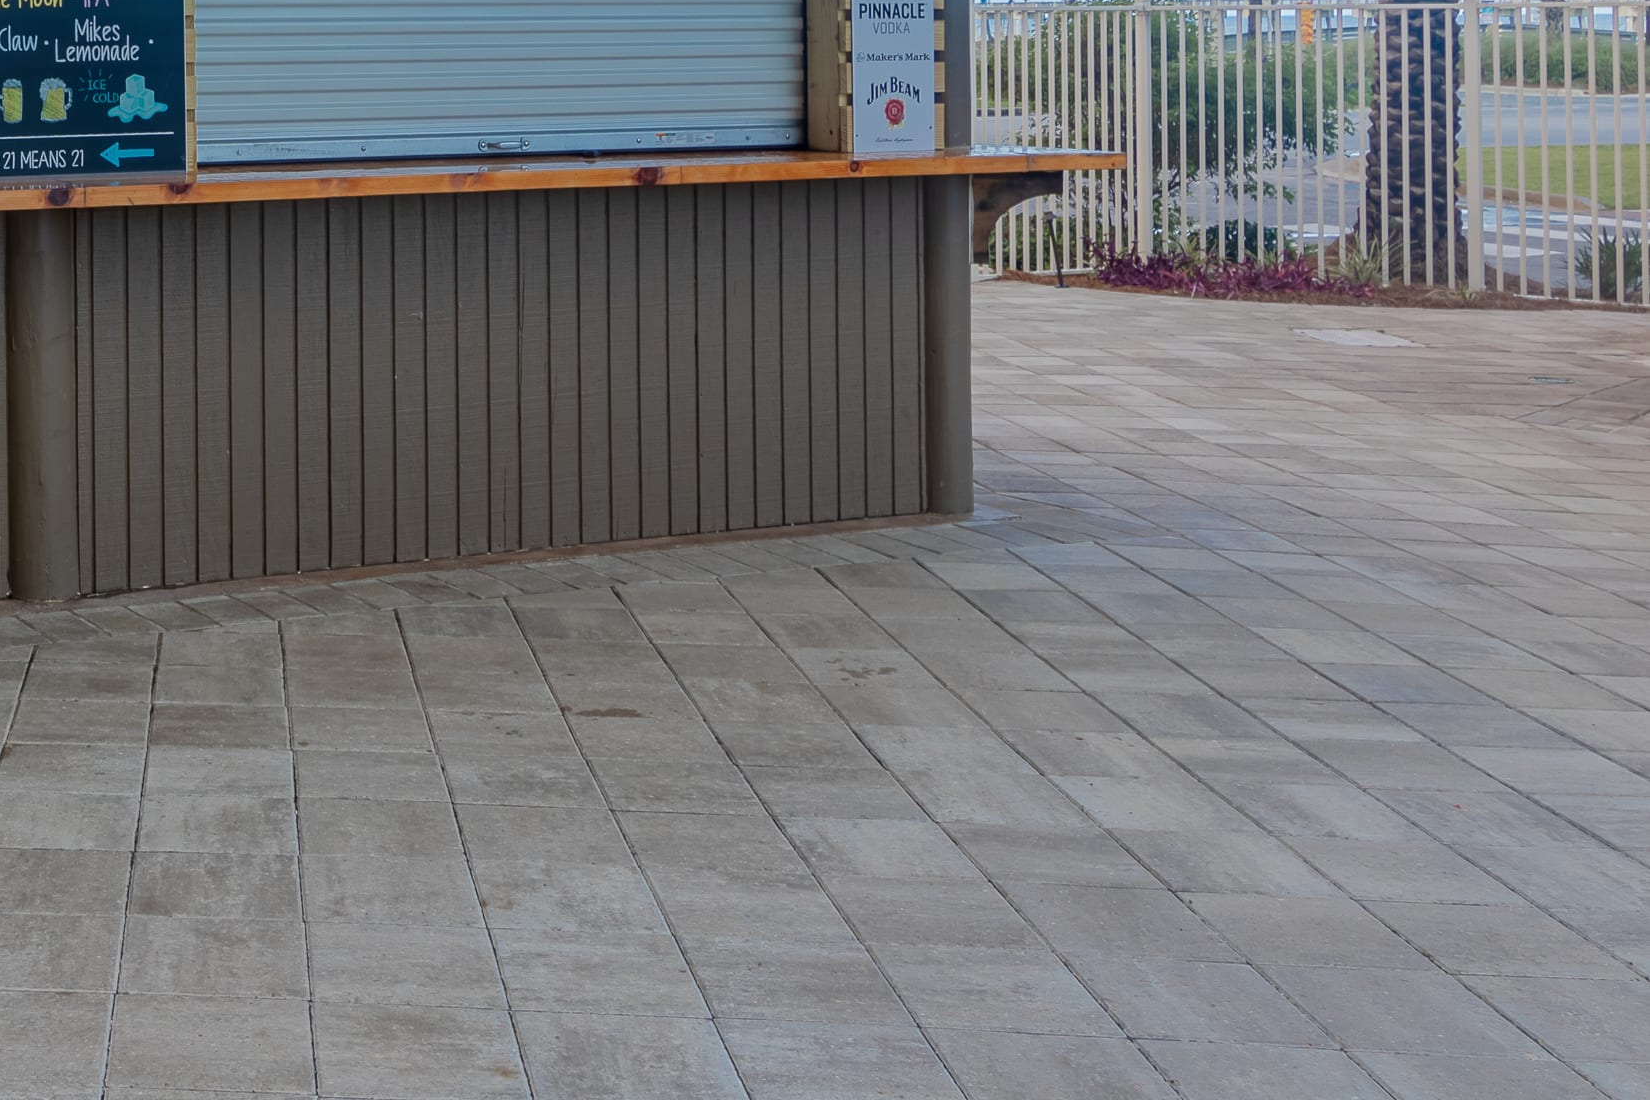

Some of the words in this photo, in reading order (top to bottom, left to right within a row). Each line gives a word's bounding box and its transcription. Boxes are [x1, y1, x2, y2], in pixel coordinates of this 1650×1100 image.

[859, 3, 925, 19] PINNACLE
[74, 15, 121, 43] Mikes
[872, 22, 910, 35] VODKA
[54, 35, 140, 63] Lemonade
[866, 53, 903, 62] Maker's
[905, 52, 930, 61] Mark
[87, 79, 107, 90] ICE
[867, 82, 888, 105] JIM
[890, 76, 921, 104] BEAM
[92, 92, 120, 104] COLD
[2, 150, 16, 170] 21
[20, 150, 66, 169] MEANS
[71, 149, 85, 168] 21
